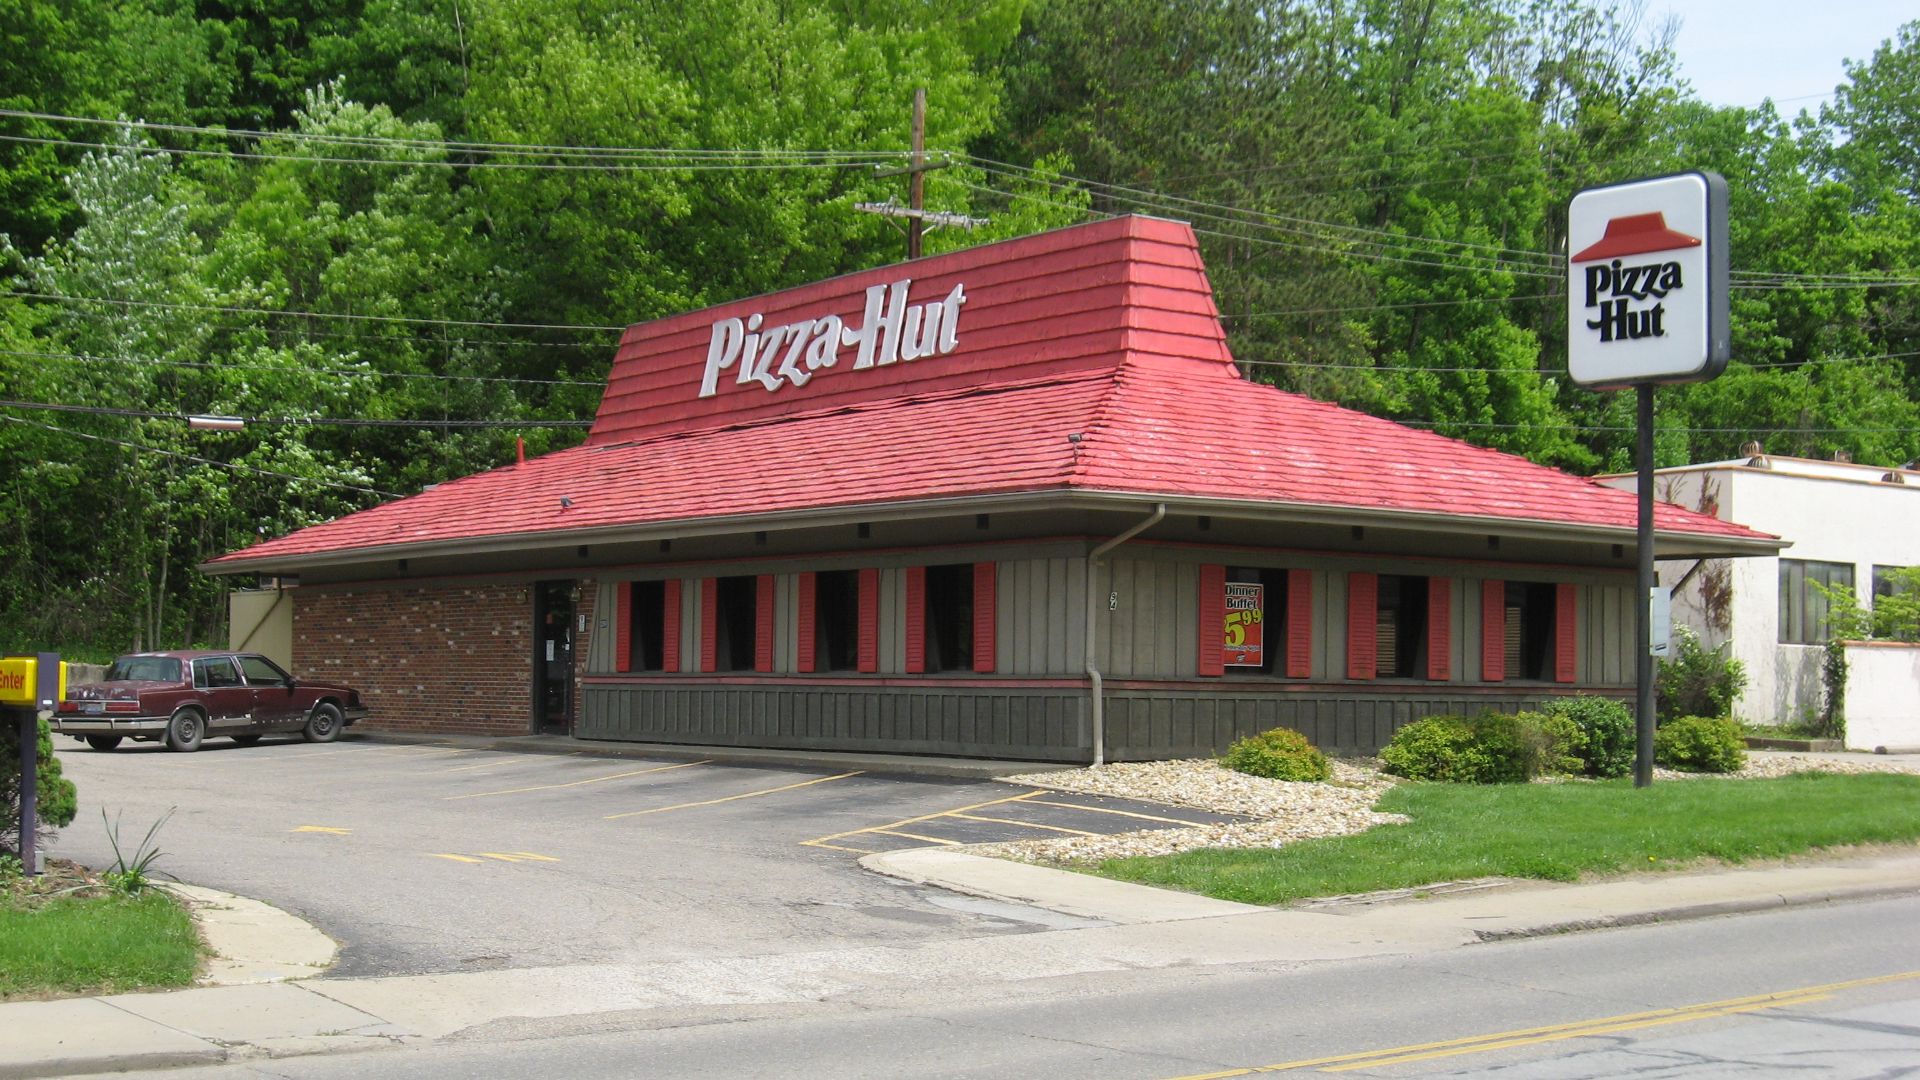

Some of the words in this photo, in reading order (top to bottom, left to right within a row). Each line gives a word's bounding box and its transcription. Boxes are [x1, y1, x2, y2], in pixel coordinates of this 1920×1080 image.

[1585, 259, 1683, 307] Pizza
[698, 313, 843, 398] Pizza
[842, 279, 967, 370] Hut
[1586, 299, 1665, 342] Hut
[1225, 585, 1260, 597] Dinner
[1226, 597, 1257, 609] Buffet
